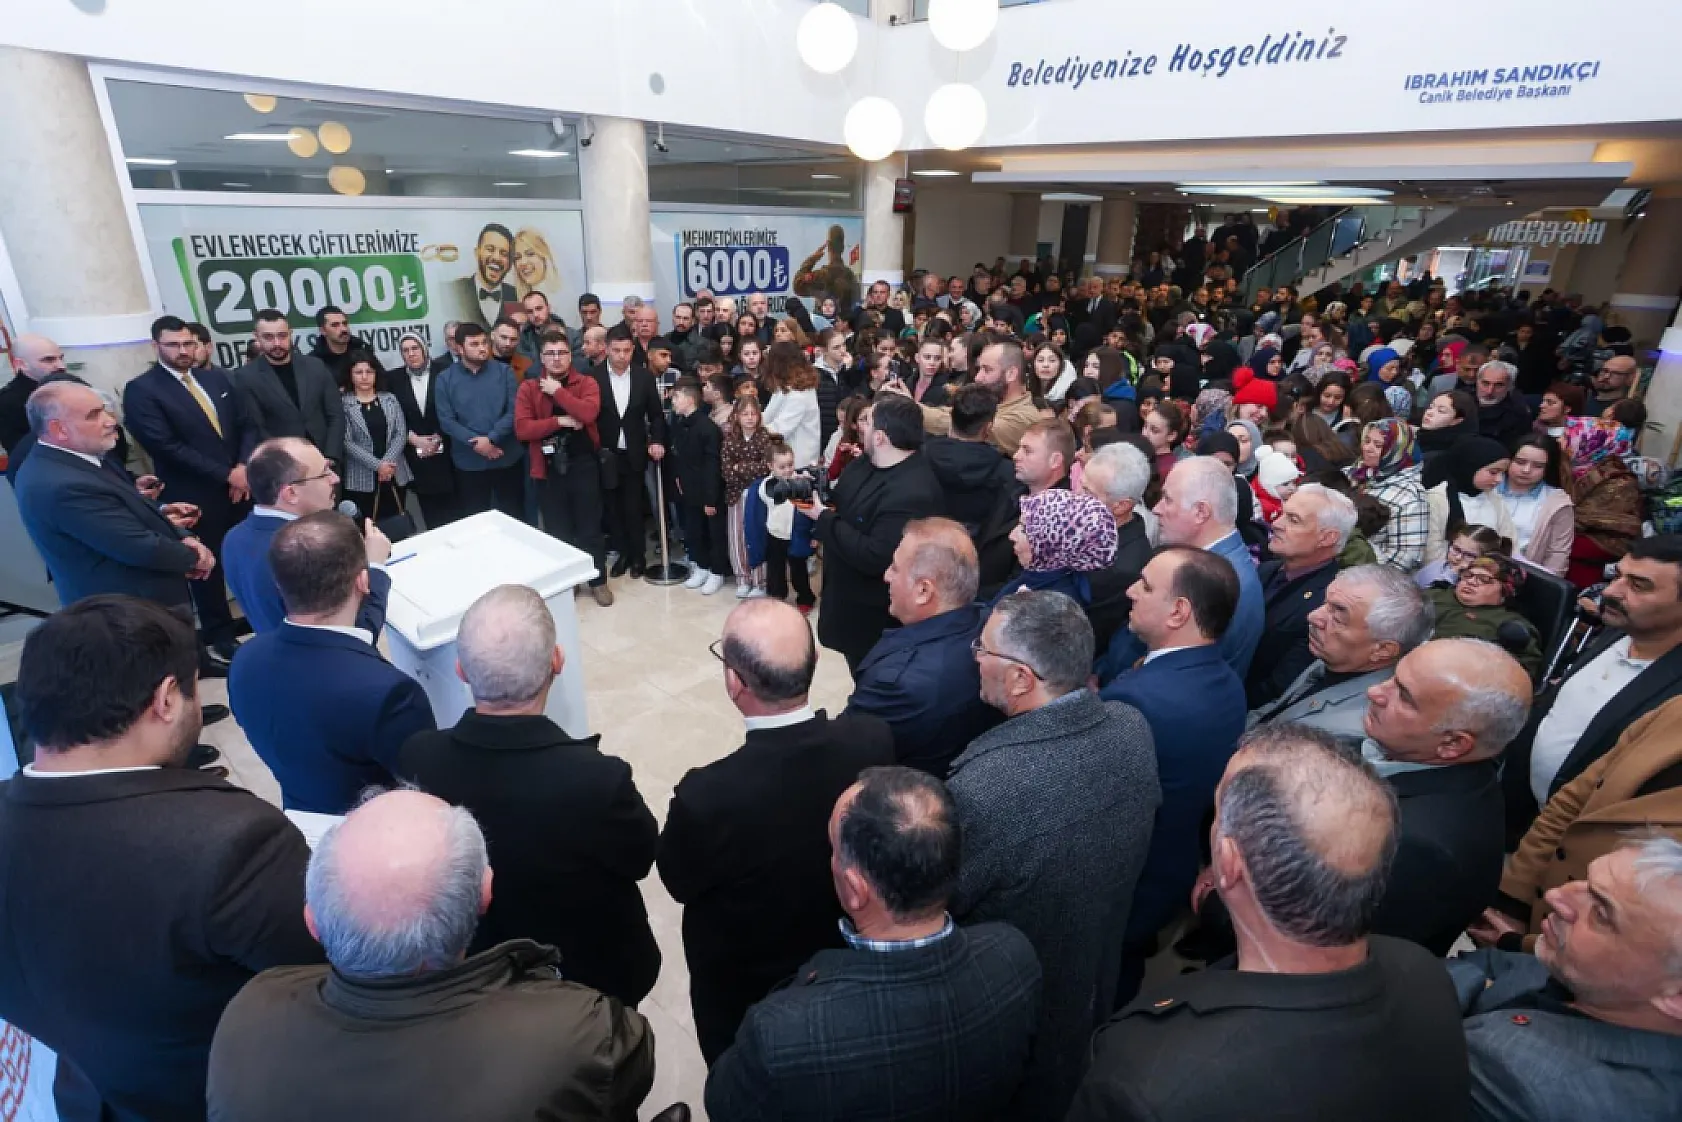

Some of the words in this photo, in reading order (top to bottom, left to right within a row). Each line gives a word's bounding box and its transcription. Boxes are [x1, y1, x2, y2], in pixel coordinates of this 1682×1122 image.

[1007, 50, 1158, 89] Belediyenize
[1168, 27, 1348, 78] Hoşgeldiniz
[1492, 60, 1601, 84] SANDIKÇI
[1418, 89, 1453, 104] Canik
[1456, 86, 1513, 102] Belediye
[1516, 84, 1572, 99] Başkanı
[190, 234, 306, 258] EVLENECEK
[309, 229, 420, 258] ÇİFTLERİMİZE
